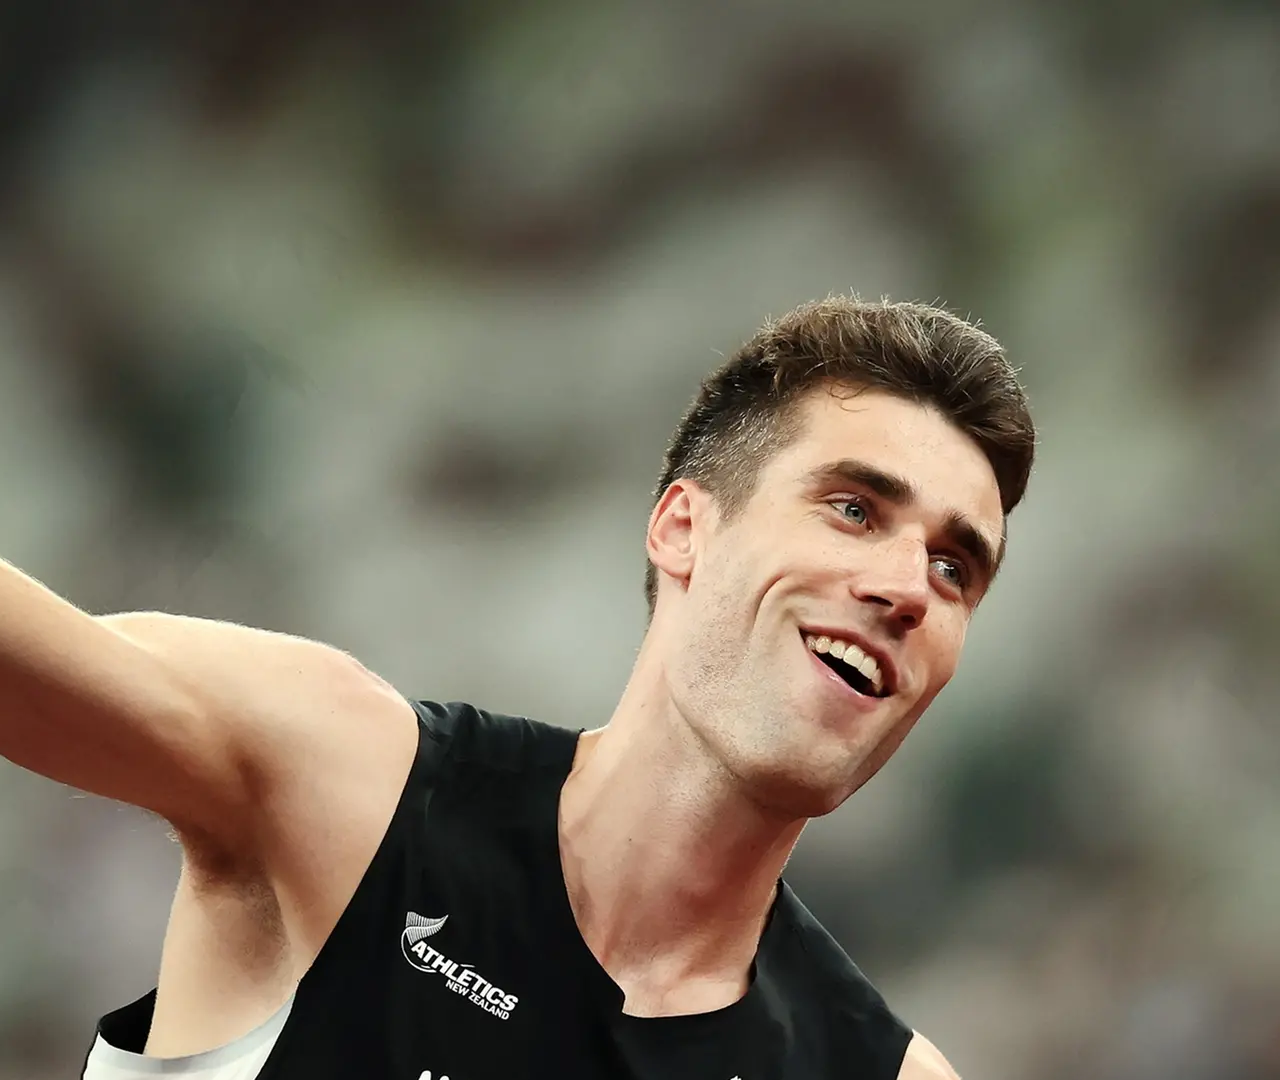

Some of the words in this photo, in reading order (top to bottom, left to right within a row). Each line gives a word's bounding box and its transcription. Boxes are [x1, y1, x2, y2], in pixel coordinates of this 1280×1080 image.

[411, 940, 519, 1011] ATHLETICS
[445, 979, 470, 996] NEW
[468, 991, 510, 1020] ZEALAND
